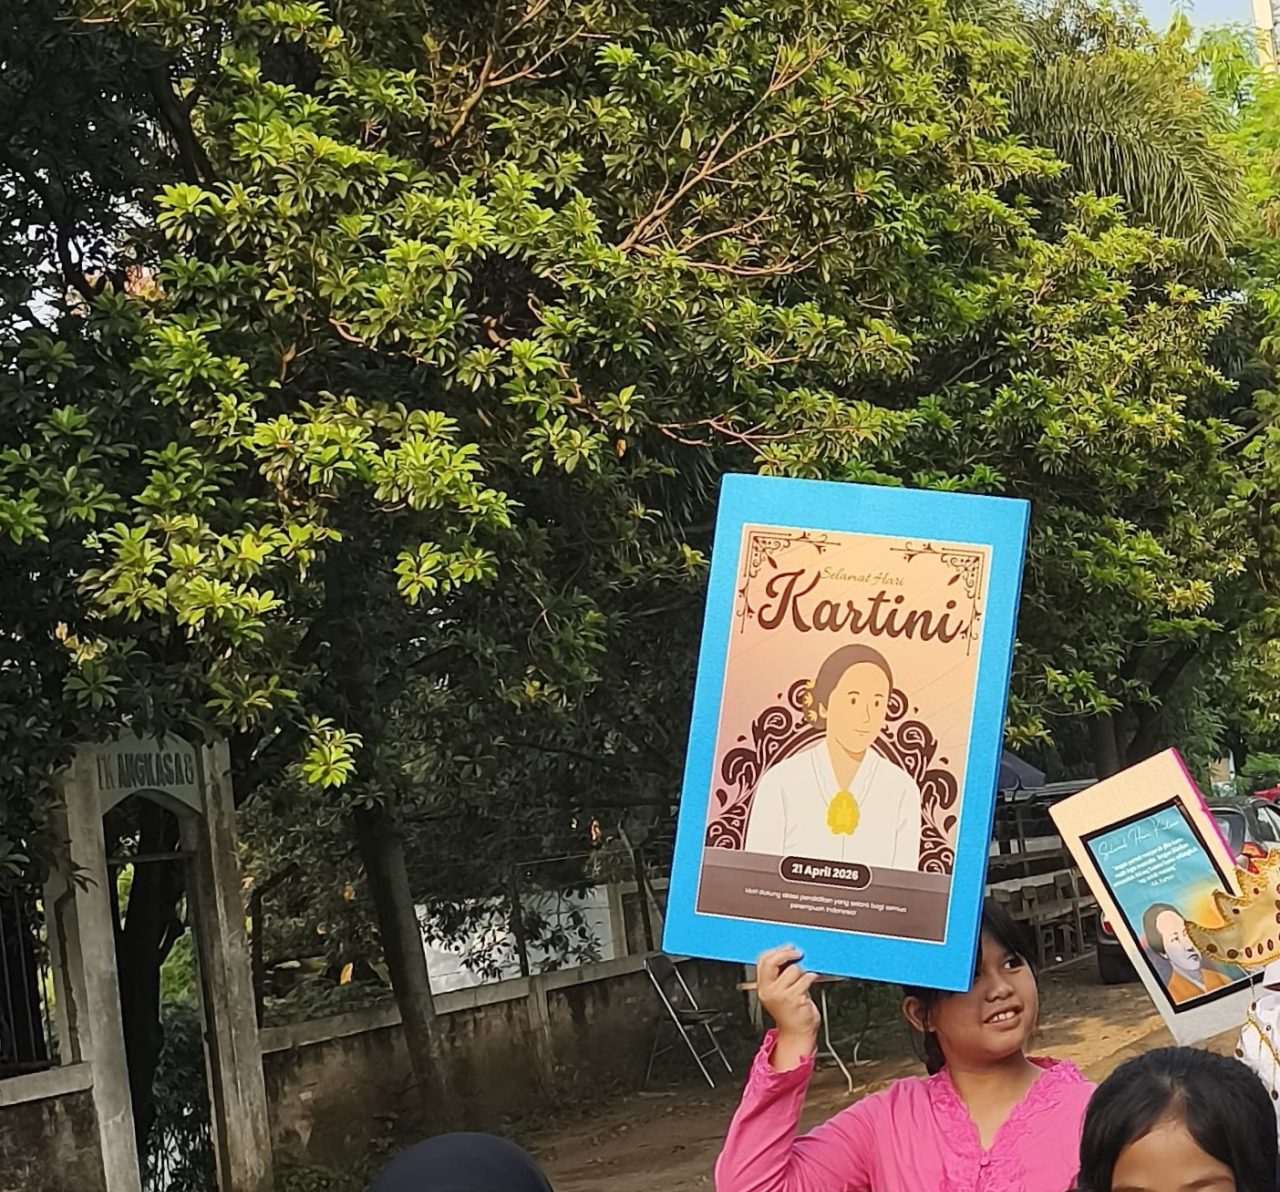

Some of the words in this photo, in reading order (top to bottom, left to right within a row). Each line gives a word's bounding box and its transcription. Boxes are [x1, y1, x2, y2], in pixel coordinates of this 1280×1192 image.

[758, 568, 964, 643] Kartini
[117, 753, 186, 789] ANGKASA
[791, 863, 804, 874] 21
[804, 865, 831, 879] April
[832, 868, 860, 881] 2026
